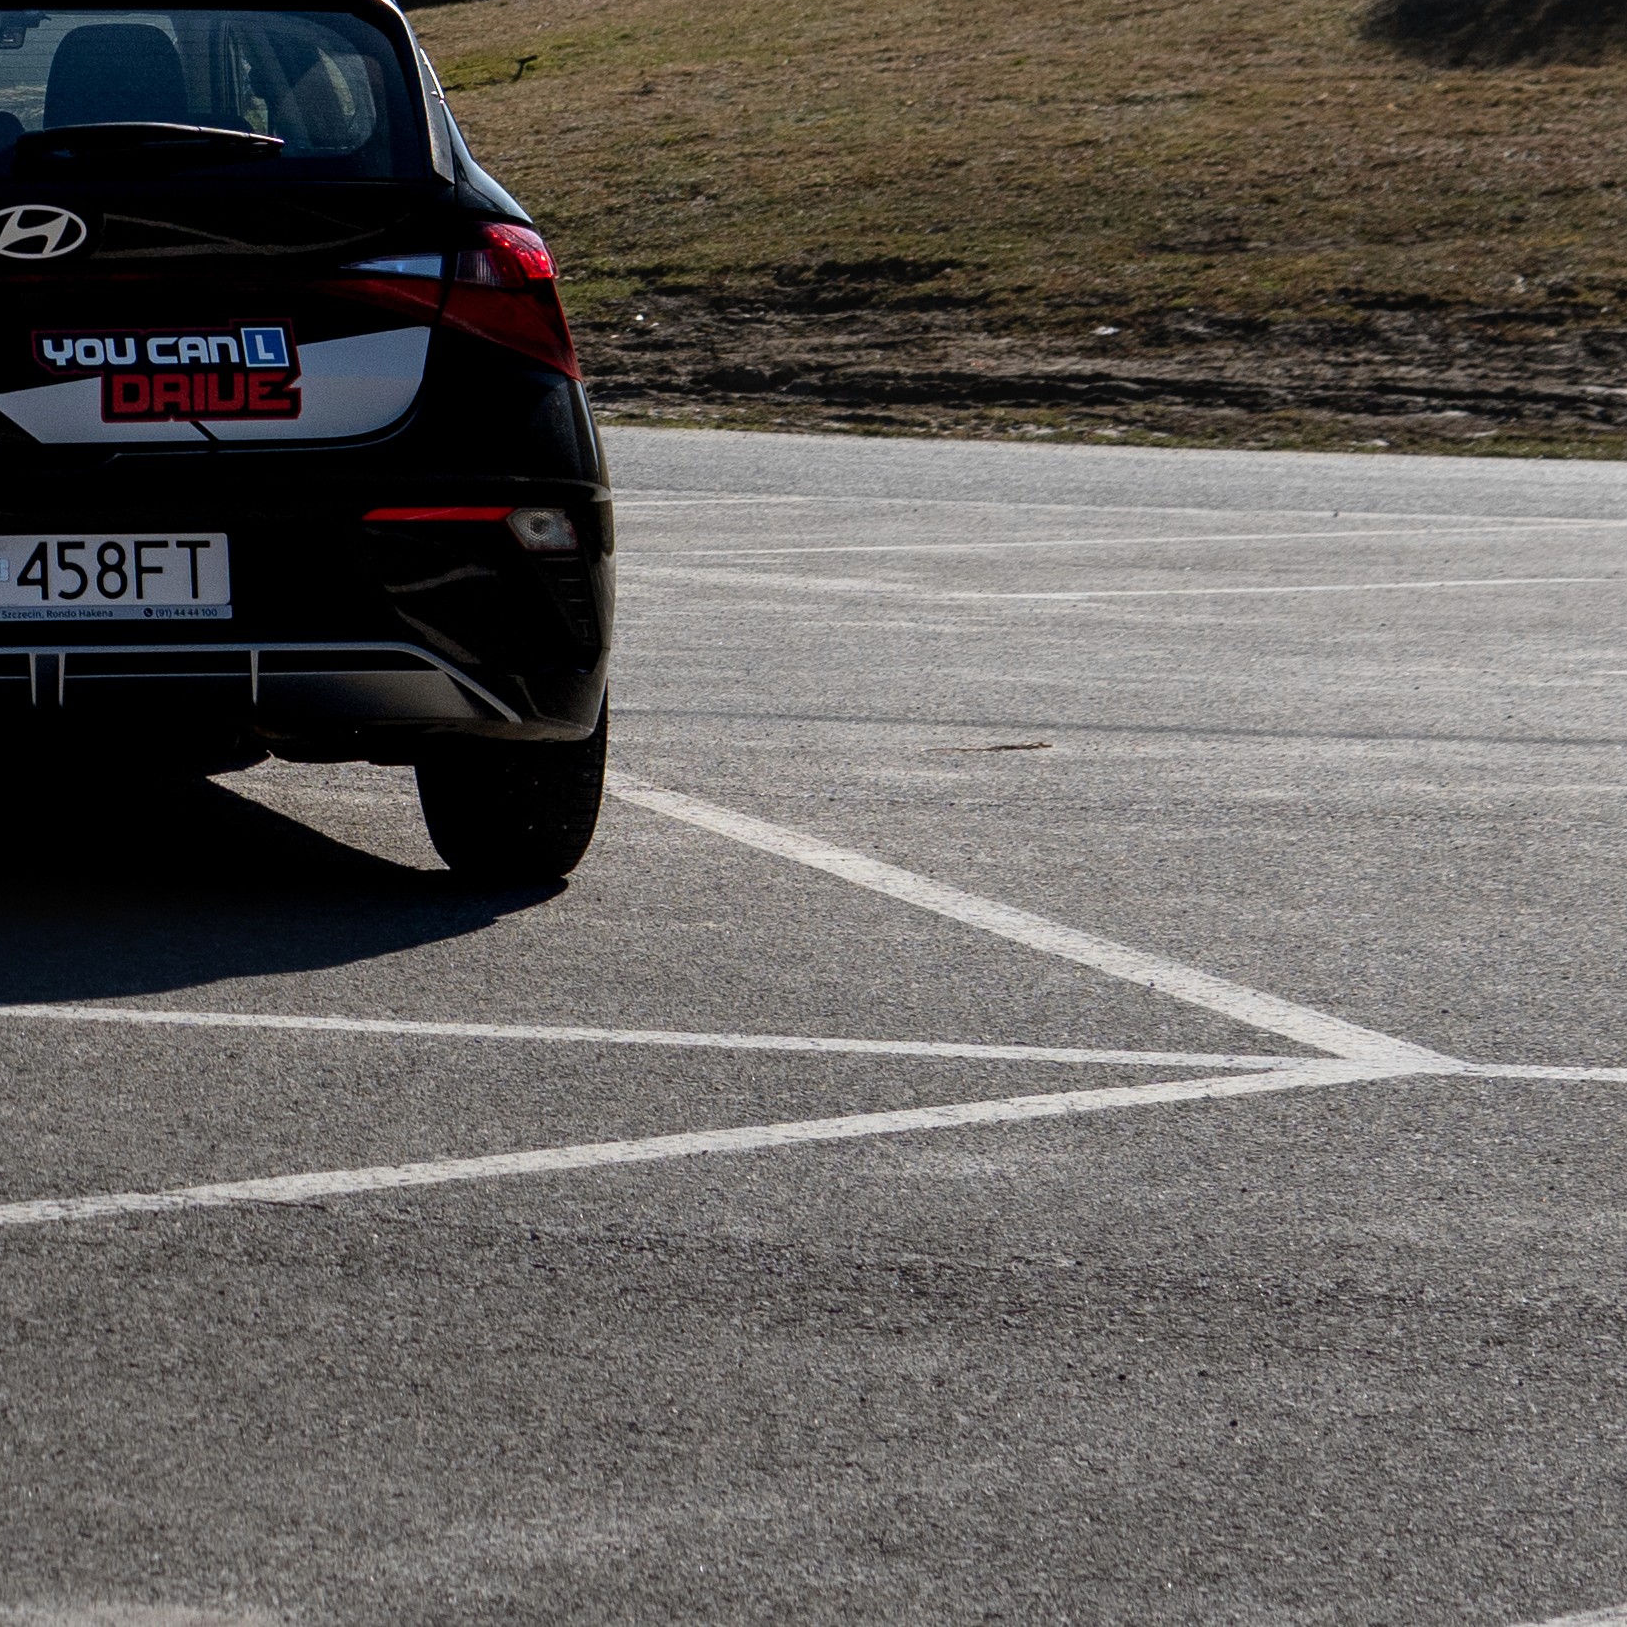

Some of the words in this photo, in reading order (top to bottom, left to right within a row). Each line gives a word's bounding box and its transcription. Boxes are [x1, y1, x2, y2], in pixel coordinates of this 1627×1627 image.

[42, 337, 137, 366] YOU
[146, 336, 240, 364] CAN
[254, 334, 275, 360] L
[112, 373, 293, 414] DRIVE
[16, 540, 211, 600] 458FT
[1, 609, 45, 620] Szczecin,
